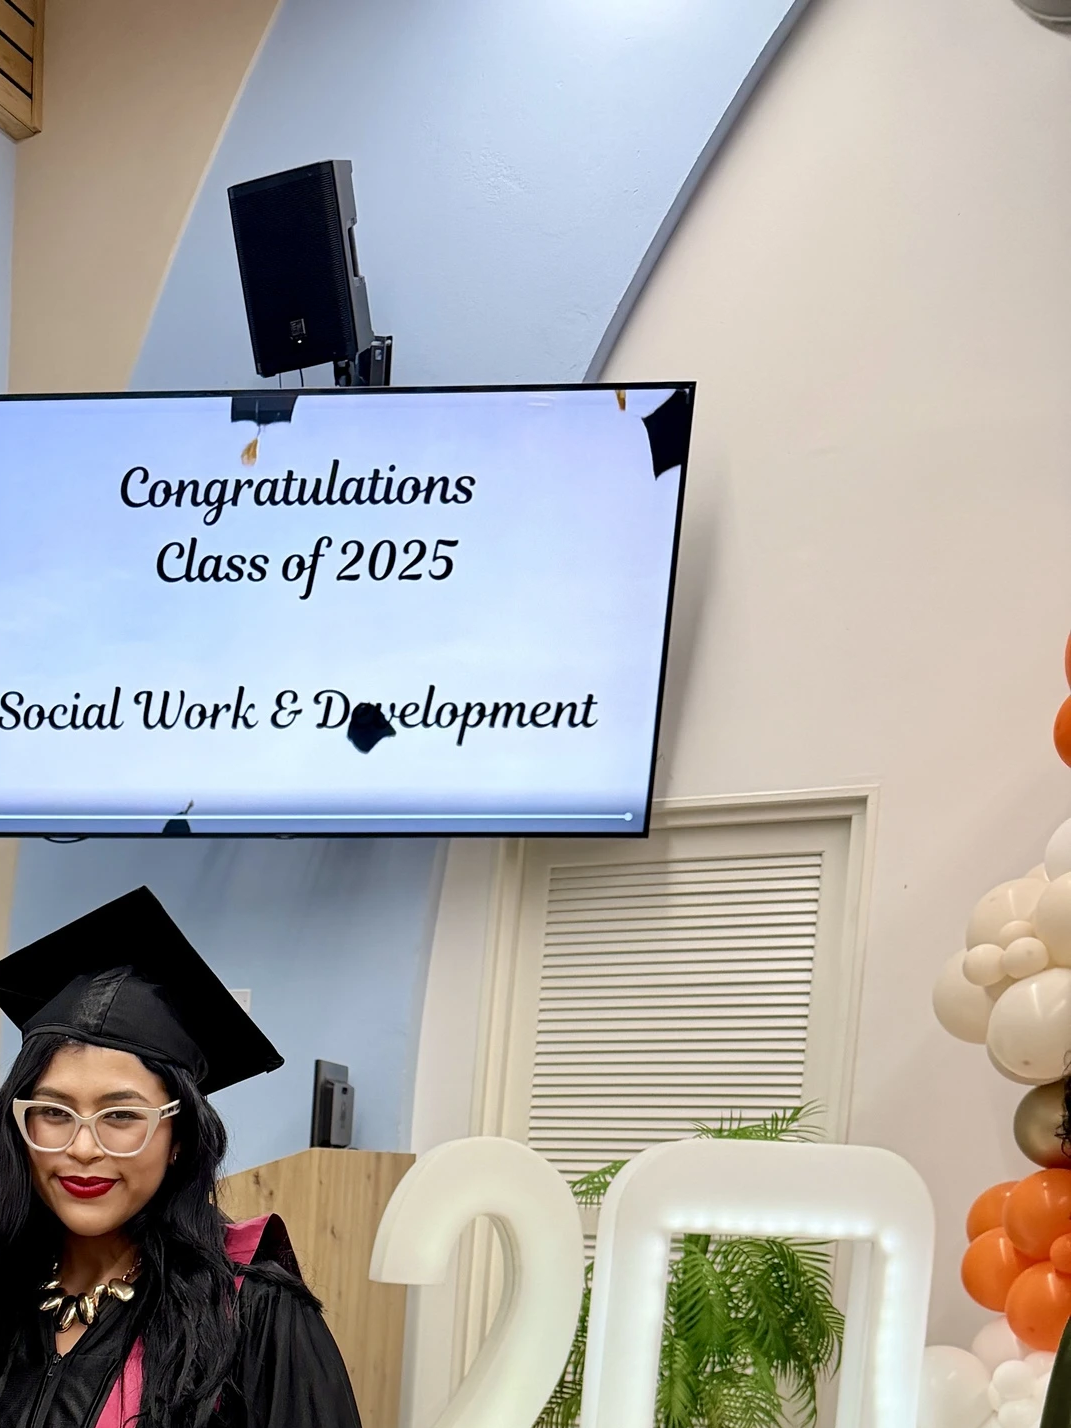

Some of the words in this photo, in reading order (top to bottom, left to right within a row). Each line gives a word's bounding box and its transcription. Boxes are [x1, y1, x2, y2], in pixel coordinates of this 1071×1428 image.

[119, 458, 477, 526] Congratulations
[156, 537, 271, 583] Class
[281, 535, 334, 601] of
[336, 539, 460, 582] 2025
[132, 685, 259, 730] Work
[270, 689, 303, 729] &
[313, 684, 598, 747] Dvelopment
